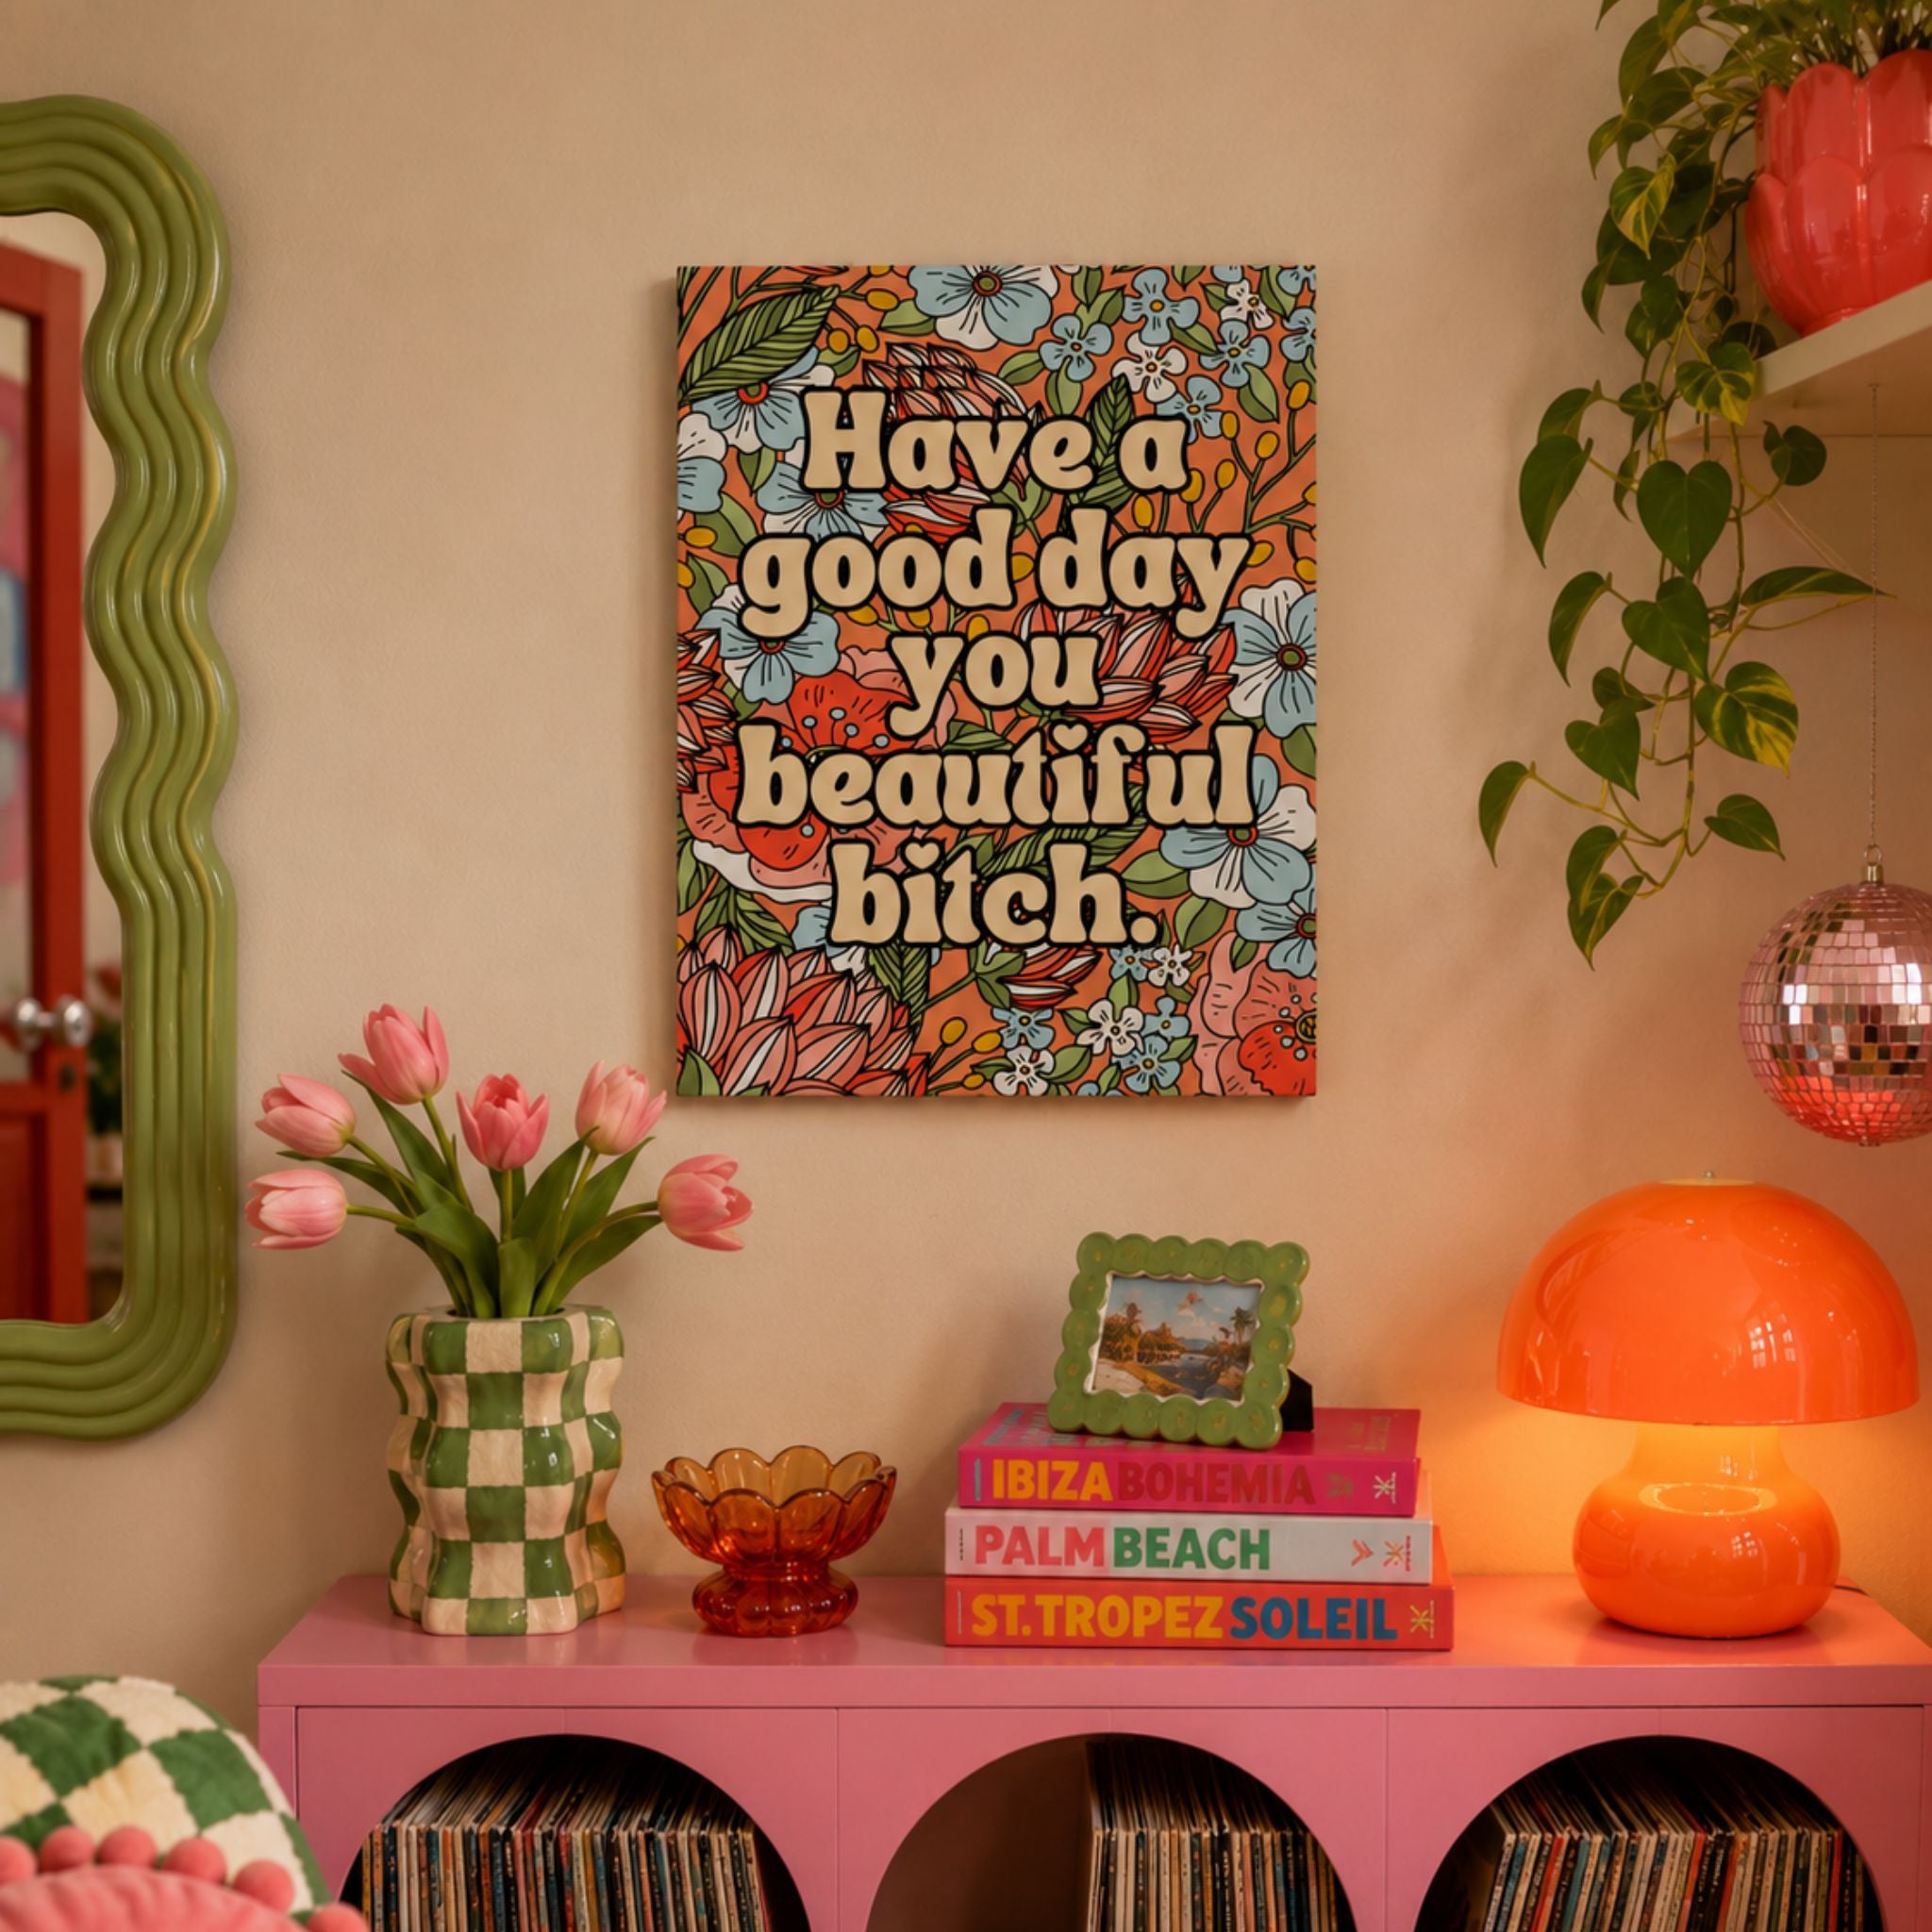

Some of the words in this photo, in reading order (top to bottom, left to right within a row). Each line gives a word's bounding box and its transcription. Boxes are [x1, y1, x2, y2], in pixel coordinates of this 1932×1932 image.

[801, 388, 1095, 491] Have
[1120, 417, 1189, 491] a
[739, 506, 1017, 639] good
[1038, 506, 1252, 640] day
[886, 633, 1102, 737] you
[736, 722, 1257, 825] beautiful
[829, 840, 1159, 944] bitch.
[992, 1458, 1113, 1502] IBIZA
[1118, 1461, 1315, 1505] BOHEMIA
[975, 1524, 1105, 1567] PALM
[1113, 1526, 1270, 1570] BEACH
[1230, 1596, 1398, 1640] SOLEIL
